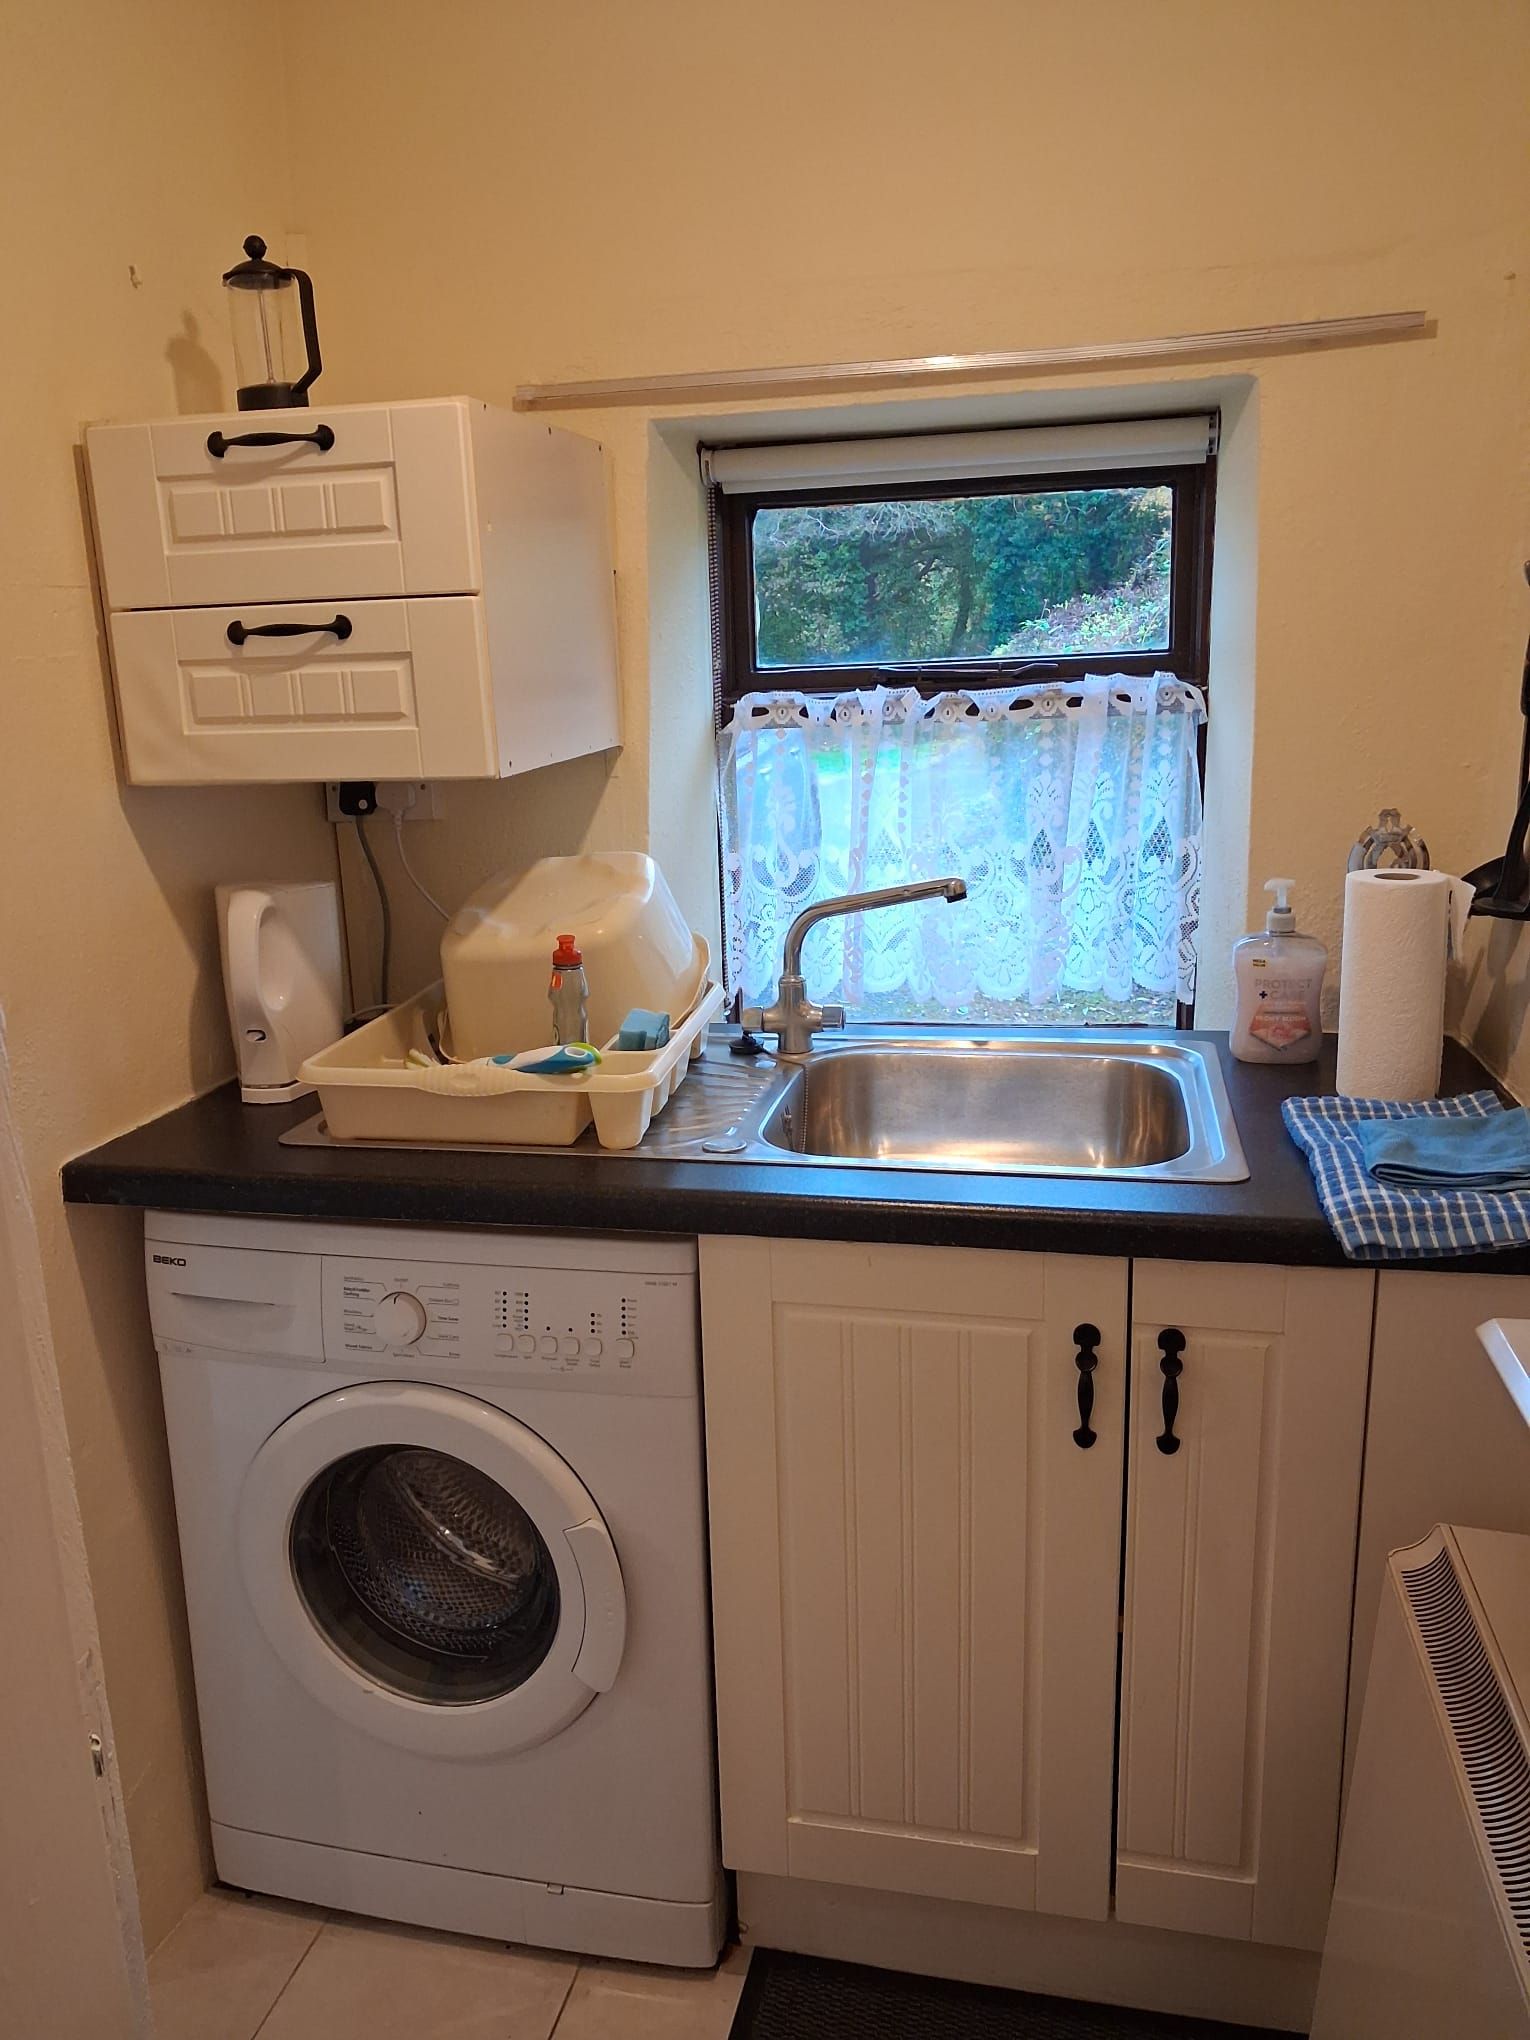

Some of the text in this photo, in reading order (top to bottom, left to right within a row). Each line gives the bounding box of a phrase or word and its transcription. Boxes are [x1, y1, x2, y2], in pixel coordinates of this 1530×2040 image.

[1255, 979, 1312, 990] PROTECT
[1270, 990, 1304, 1000] CARE
[153, 1254, 186, 1267] BEKO
